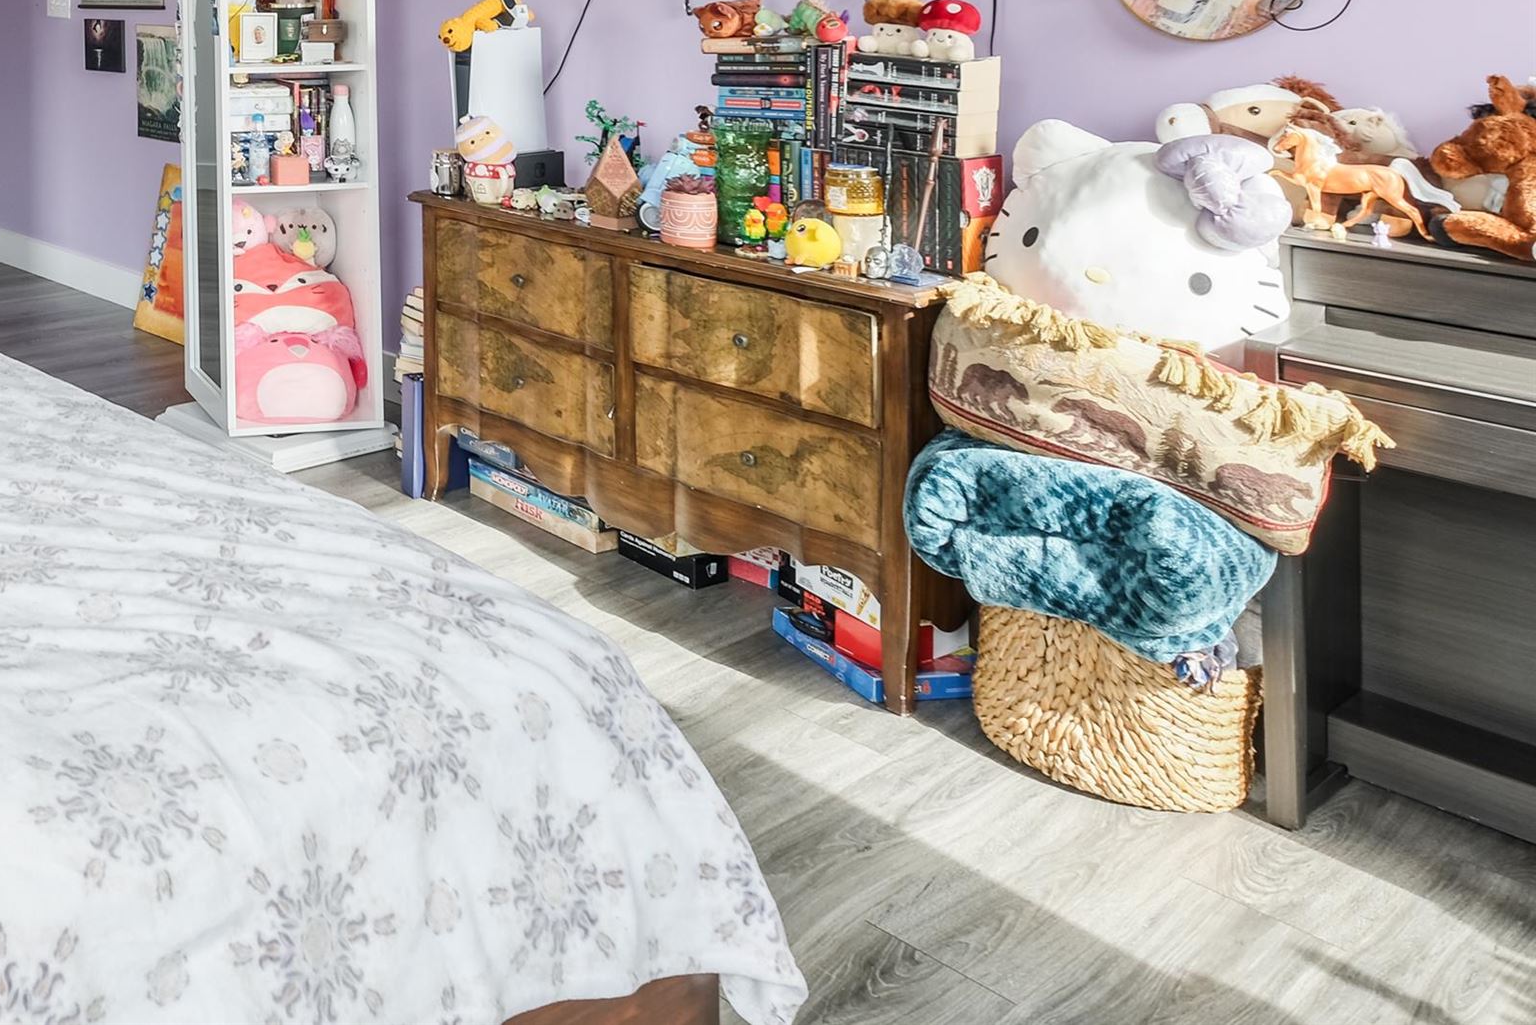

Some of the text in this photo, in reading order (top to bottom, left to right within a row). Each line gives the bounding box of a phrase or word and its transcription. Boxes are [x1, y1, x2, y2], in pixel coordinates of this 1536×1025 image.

[492, 473, 569, 513] MONOPOLY AVATAR
[822, 565, 853, 587] Poetry
